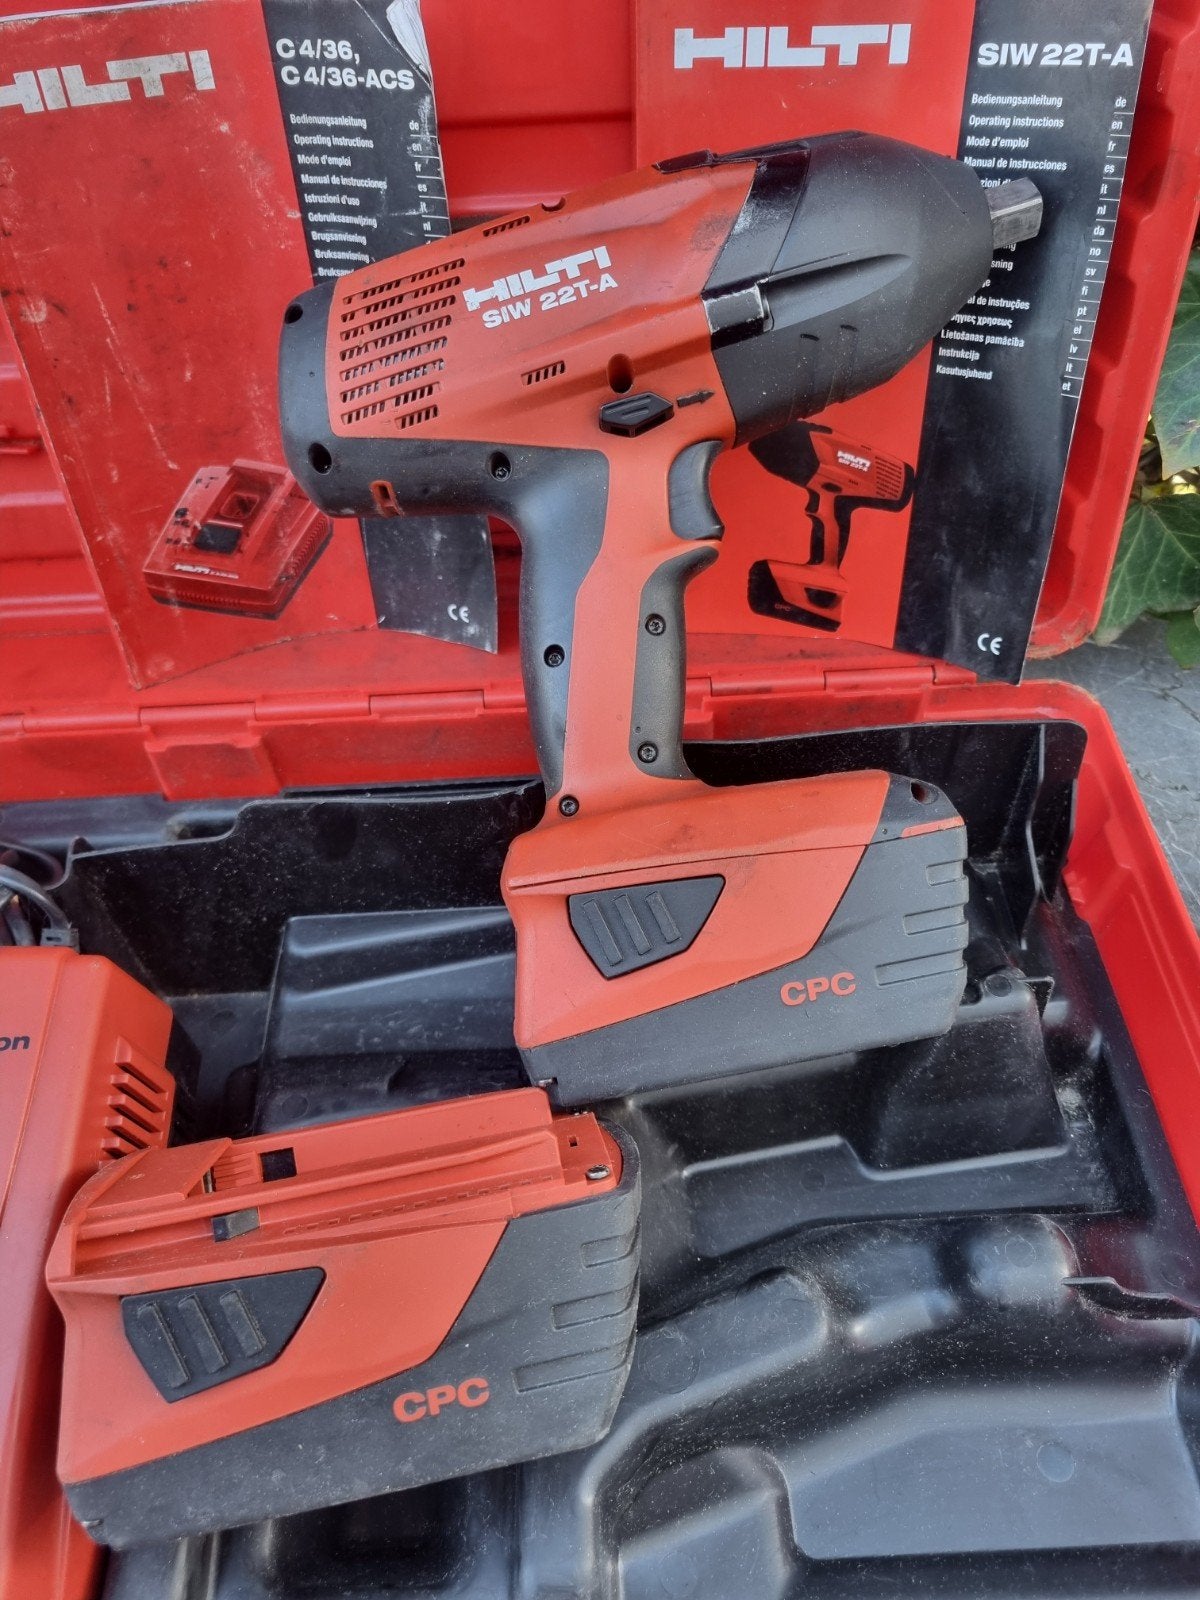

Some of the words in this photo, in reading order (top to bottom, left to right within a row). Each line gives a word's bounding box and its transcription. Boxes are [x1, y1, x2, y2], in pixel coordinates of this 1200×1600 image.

[276, 38, 295, 58] C
[299, 38, 360, 64] 4/36,
[674, 24, 911, 68] HILTI
[977, 43, 1038, 66] SIW
[1040, 43, 1133, 66] 22T-A
[281, 65, 300, 85] C
[303, 66, 415, 90] 4/36-ACS
[971, 93, 1063, 107] Bedienungsanleitung
[1115, 97, 1127, 107] de
[290, 114, 367, 130] Bedienungsanleitung
[409, 121, 420, 131] de
[969, 115, 1010, 128] Operating
[1012, 116, 1064, 129] instructions
[1111, 121, 1123, 130] en
[294, 134, 331, 147] Operating
[332, 135, 374, 149] instructions
[966, 136, 990, 147] Mode
[1108, 141, 1116, 152] fr
[297, 154, 320, 165] Mode
[964, 157, 996, 168] Manual
[997, 158, 1008, 168] de
[1009, 159, 1067, 171] instrucciones
[415, 161, 422, 172] fr
[1104, 164, 1115, 173] es
[301, 174, 330, 185] Manual
[331, 175, 341, 185] de
[341, 176, 388, 189] instrucciones
[418, 183, 427, 192] es
[1100, 184, 1108, 194] it
[304, 194, 340, 204] Istruzioni
[1096, 205, 1106, 215] nl
[308, 212, 377, 229] Gebruiksaanwijzing
[1093, 226, 1105, 236] da
[311, 231, 367, 246] Brugsanvisning
[1089, 246, 1101, 255] no
[314, 249, 370, 264] Bruksanvisning
[1085, 267, 1096, 276] sv
[462, 245, 612, 312] HILTI
[1081, 285, 1089, 295] fi
[482, 299, 531, 329] SIW
[539, 273, 618, 311] 22T-A
[976, 296, 987, 306] de
[1076, 306, 1087, 317] pt
[1073, 325, 1083, 335] el
[938, 347, 980, 361] Instrukcija
[936, 364, 994, 380] Kasutusjuhend
[1062, 381, 1072, 391] et
[780, 971, 856, 1006] CPC
[393, 1377, 490, 1423] CPC
